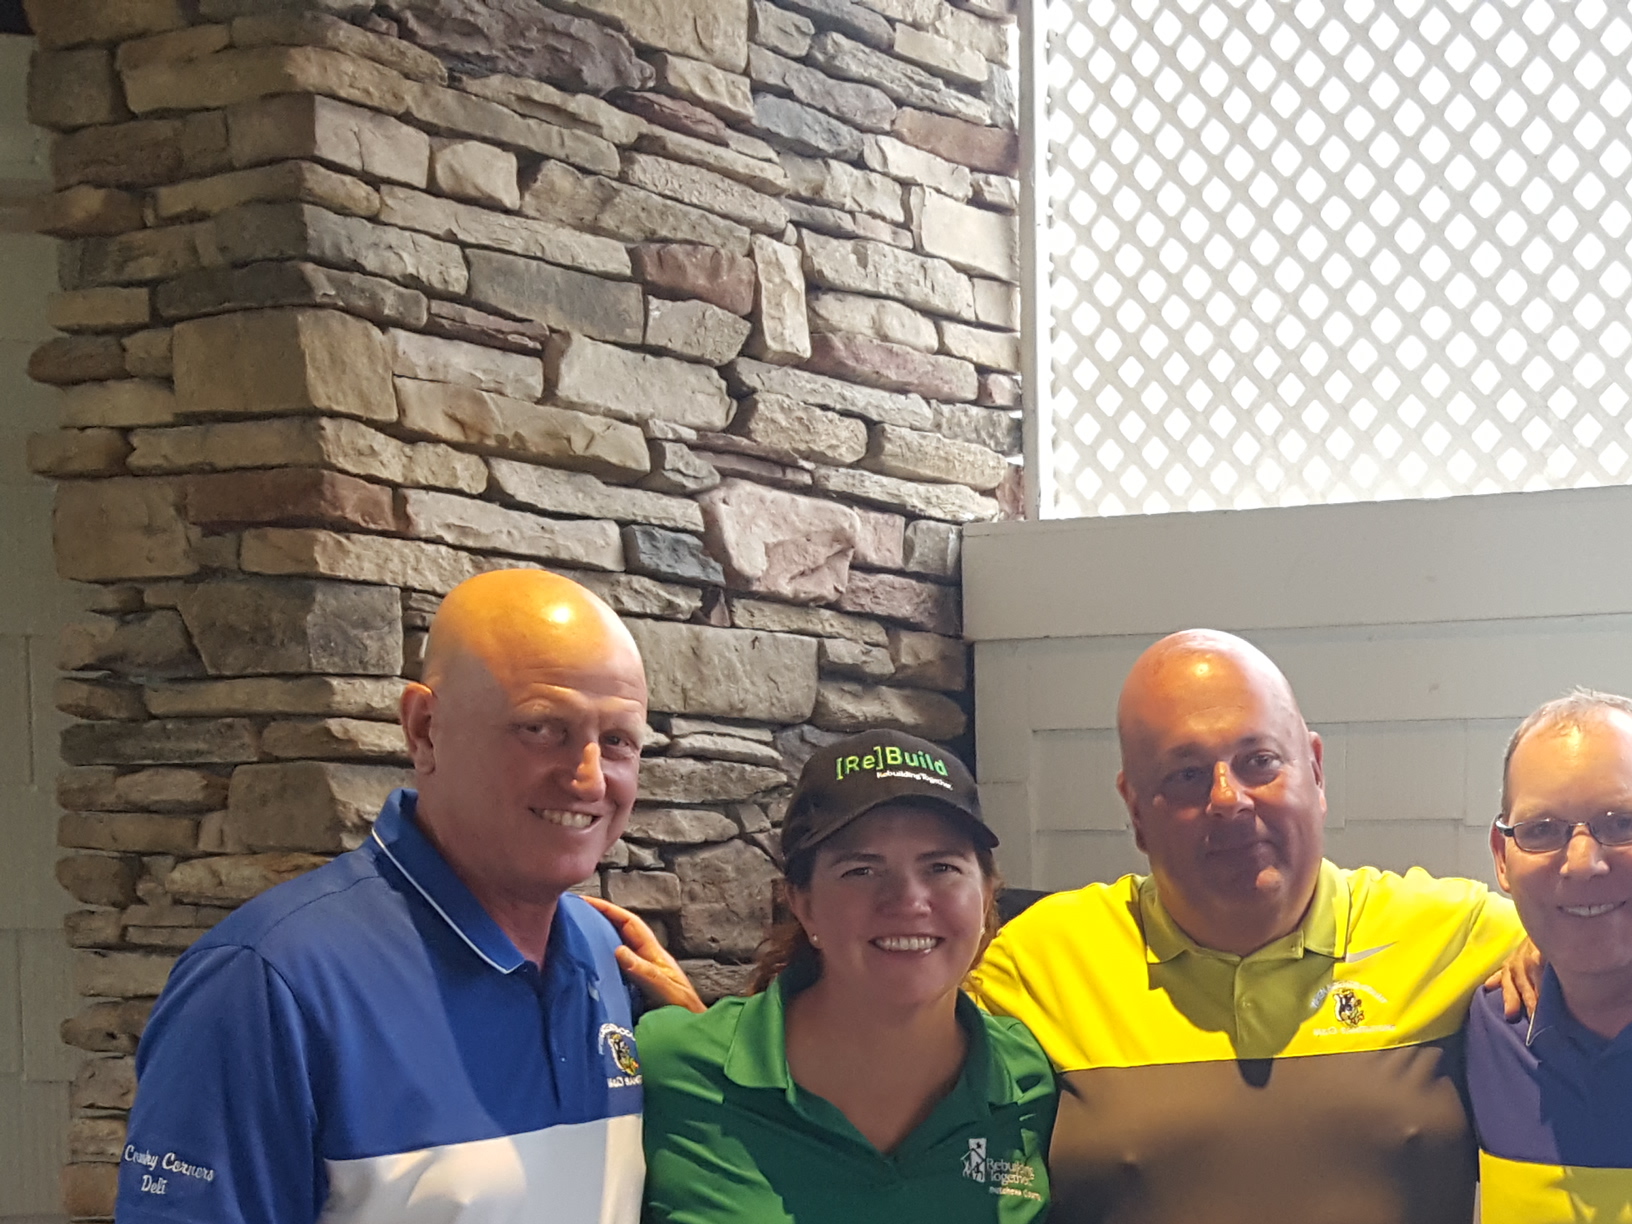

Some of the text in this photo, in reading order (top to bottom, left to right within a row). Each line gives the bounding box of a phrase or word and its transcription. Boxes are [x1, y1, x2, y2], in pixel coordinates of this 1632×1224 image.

[836, 745, 949, 781] [Re]Build
[162, 1152, 215, 1182] Corners
[141, 1174, 168, 1195] Deli
